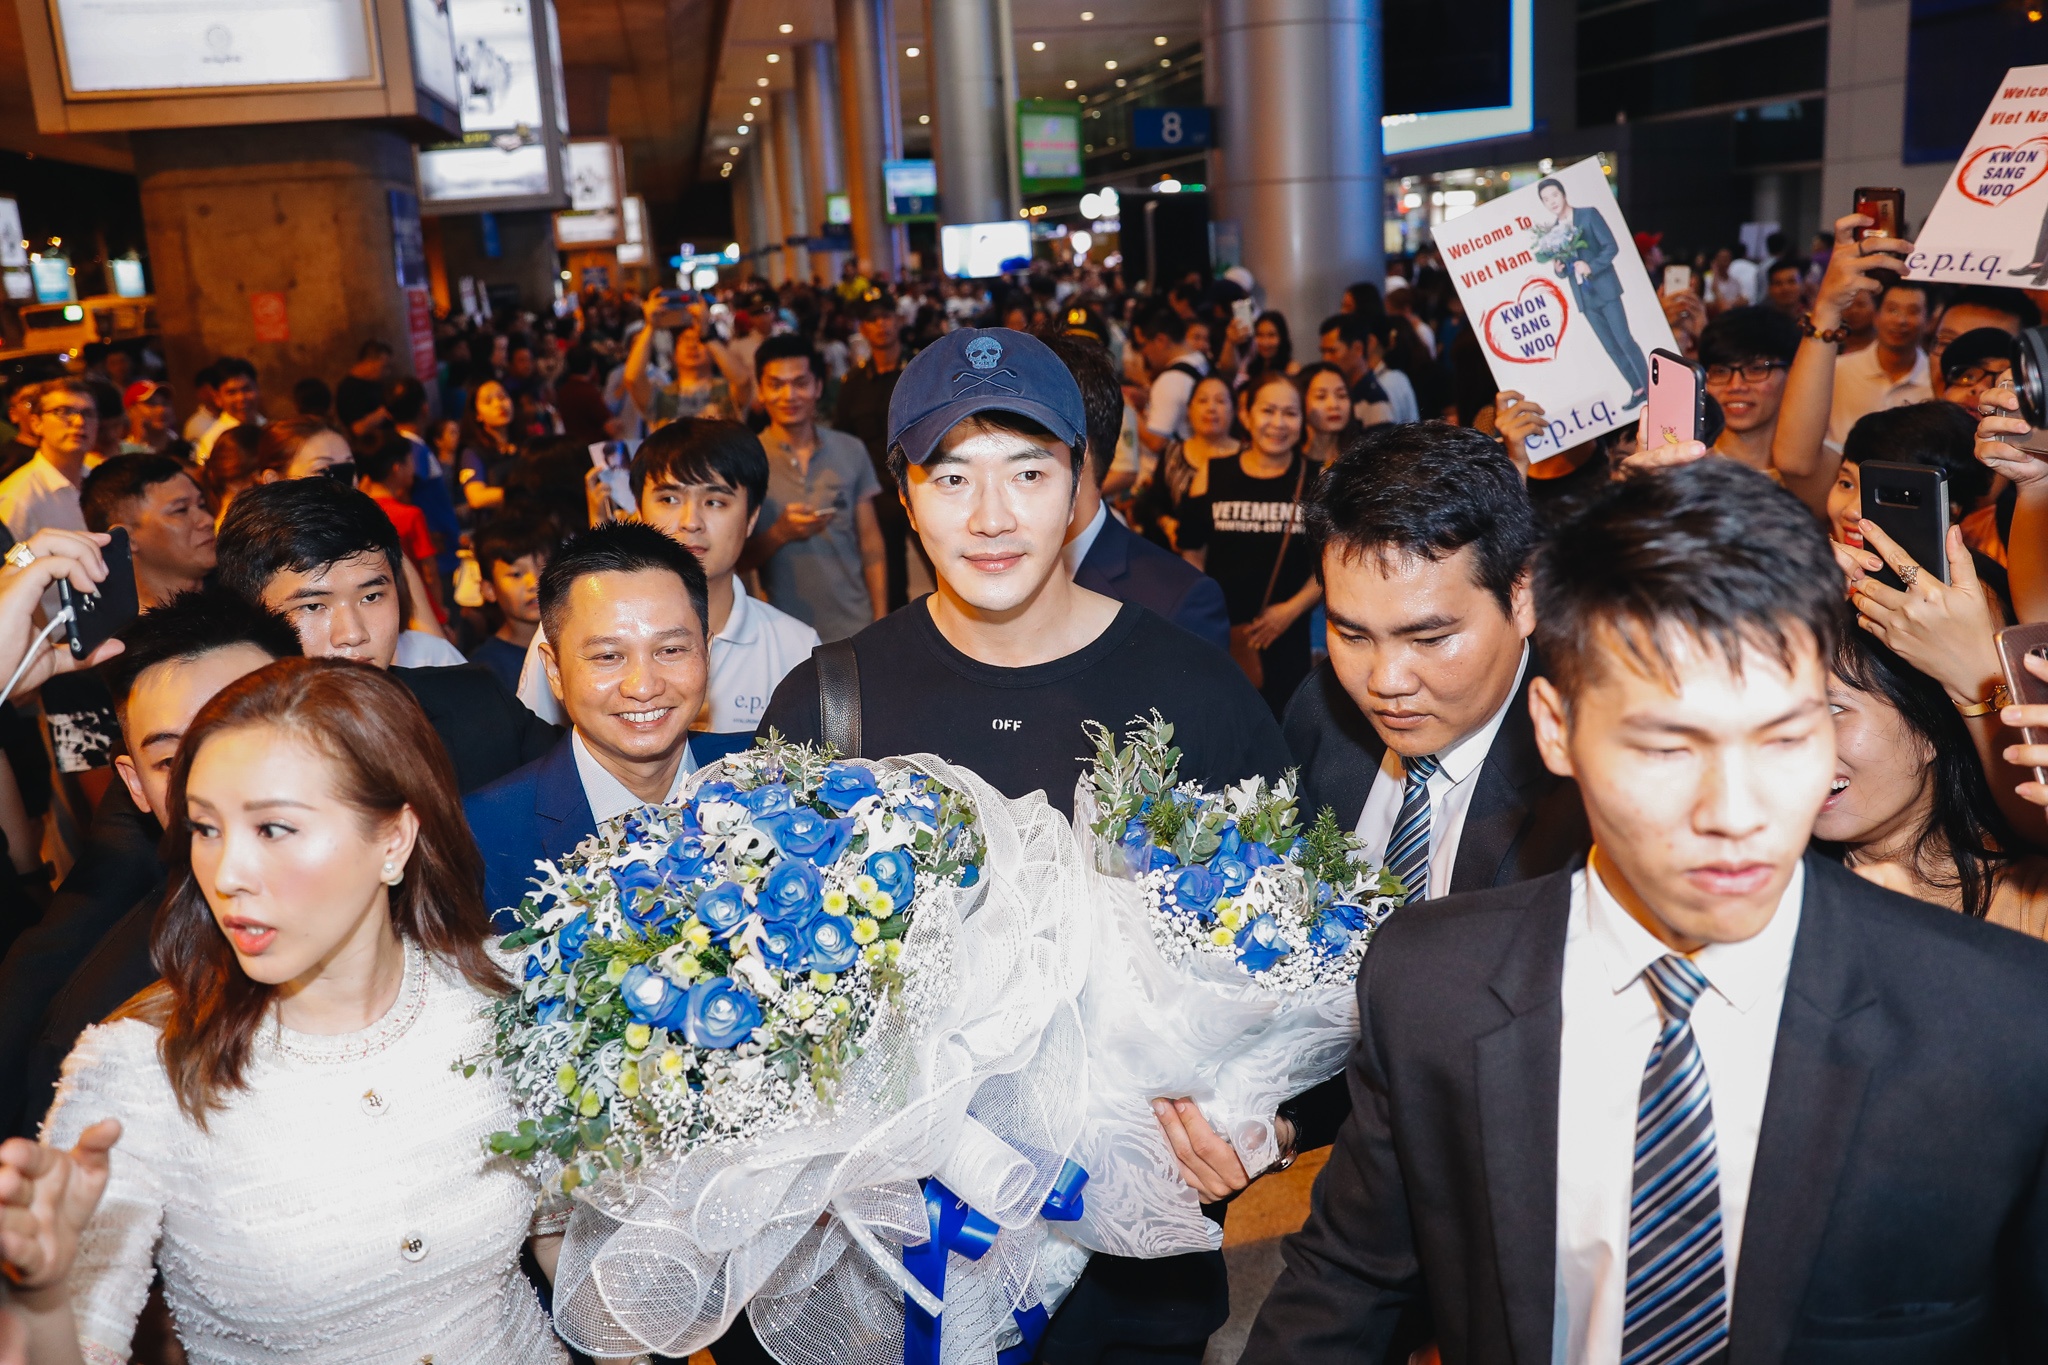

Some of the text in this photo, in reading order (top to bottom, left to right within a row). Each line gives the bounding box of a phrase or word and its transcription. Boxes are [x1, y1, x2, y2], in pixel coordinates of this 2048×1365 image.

[2004, 86, 2048, 99] Welco
[1162, 111, 1183, 144] 8
[1990, 110, 2048, 125] Viet Na
[1988, 151, 2038, 163] KWON
[1984, 167, 2025, 179] SANG
[1978, 184, 2014, 196] WOO
[1447, 216, 1532, 260] Welcome To
[1460, 250, 1532, 288] Viet Nam
[1909, 251, 2002, 280] e.p.t.q.
[1500, 294, 1546, 324] KWON
[1511, 314, 1551, 340] SANG
[1520, 333, 1556, 357] WOO
[992, 718, 1022, 731] OFF
